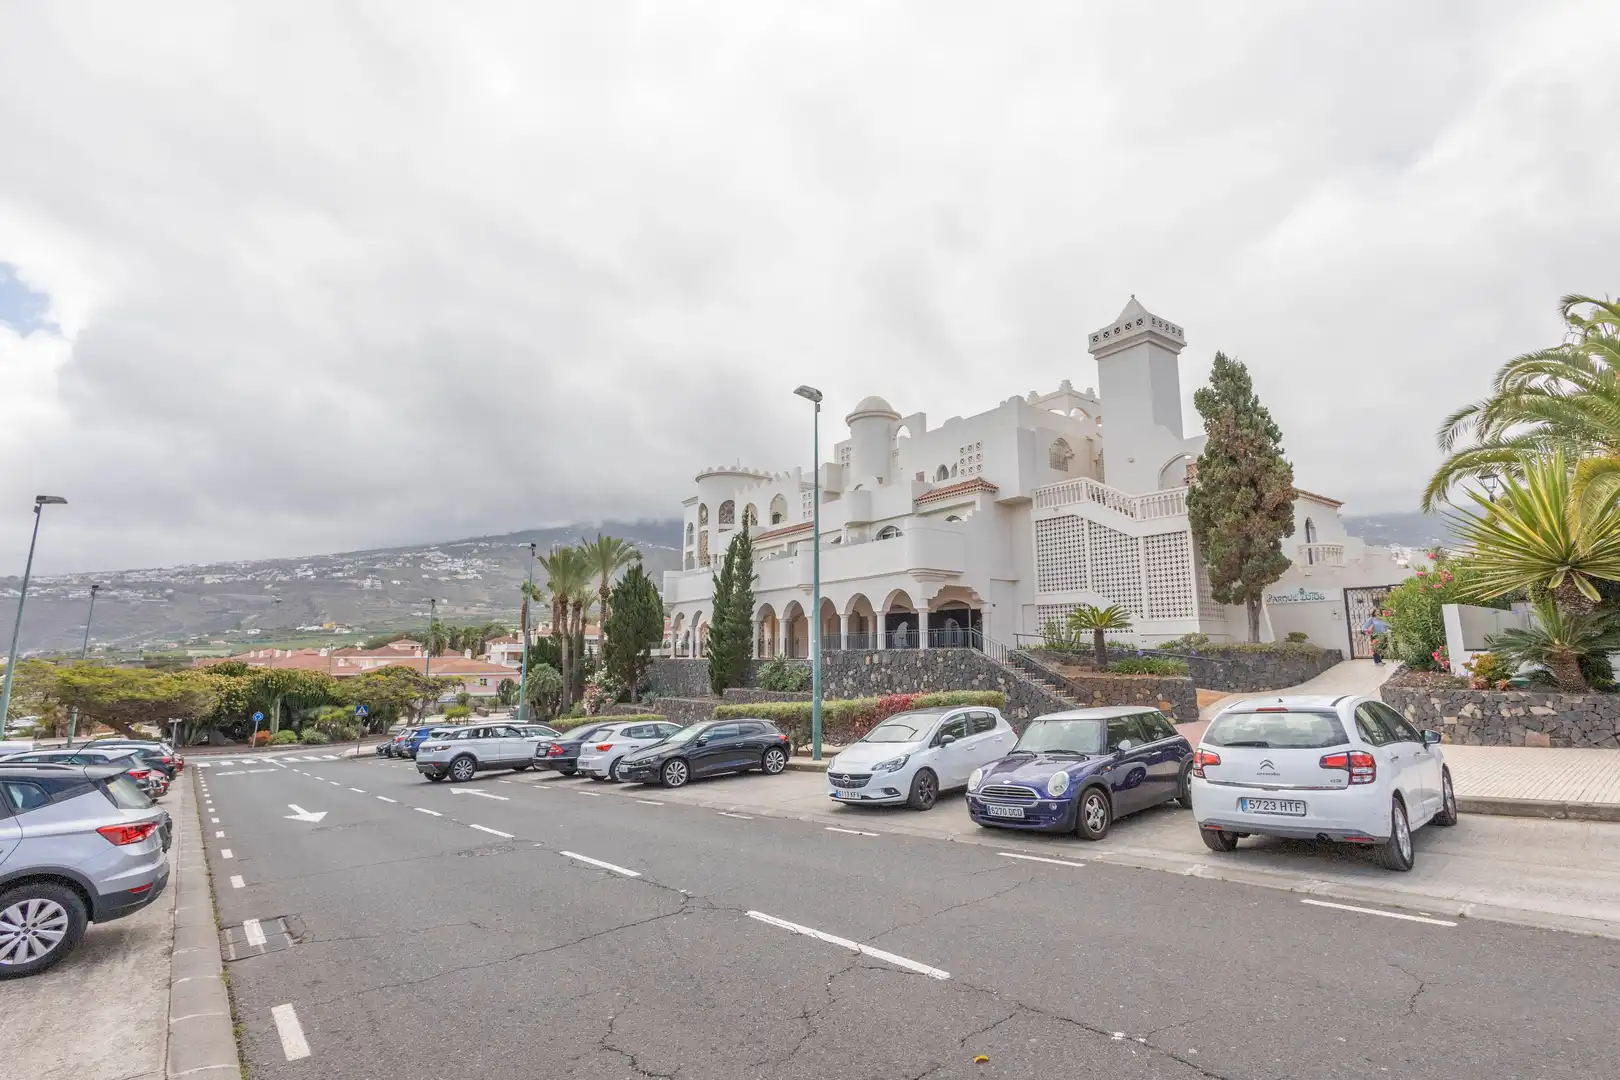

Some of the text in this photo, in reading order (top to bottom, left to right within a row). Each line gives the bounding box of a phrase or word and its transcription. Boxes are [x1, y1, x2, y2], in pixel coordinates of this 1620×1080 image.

[990, 806, 1007, 816] 6270
[1248, 800, 1302, 812] 5723 HTF
